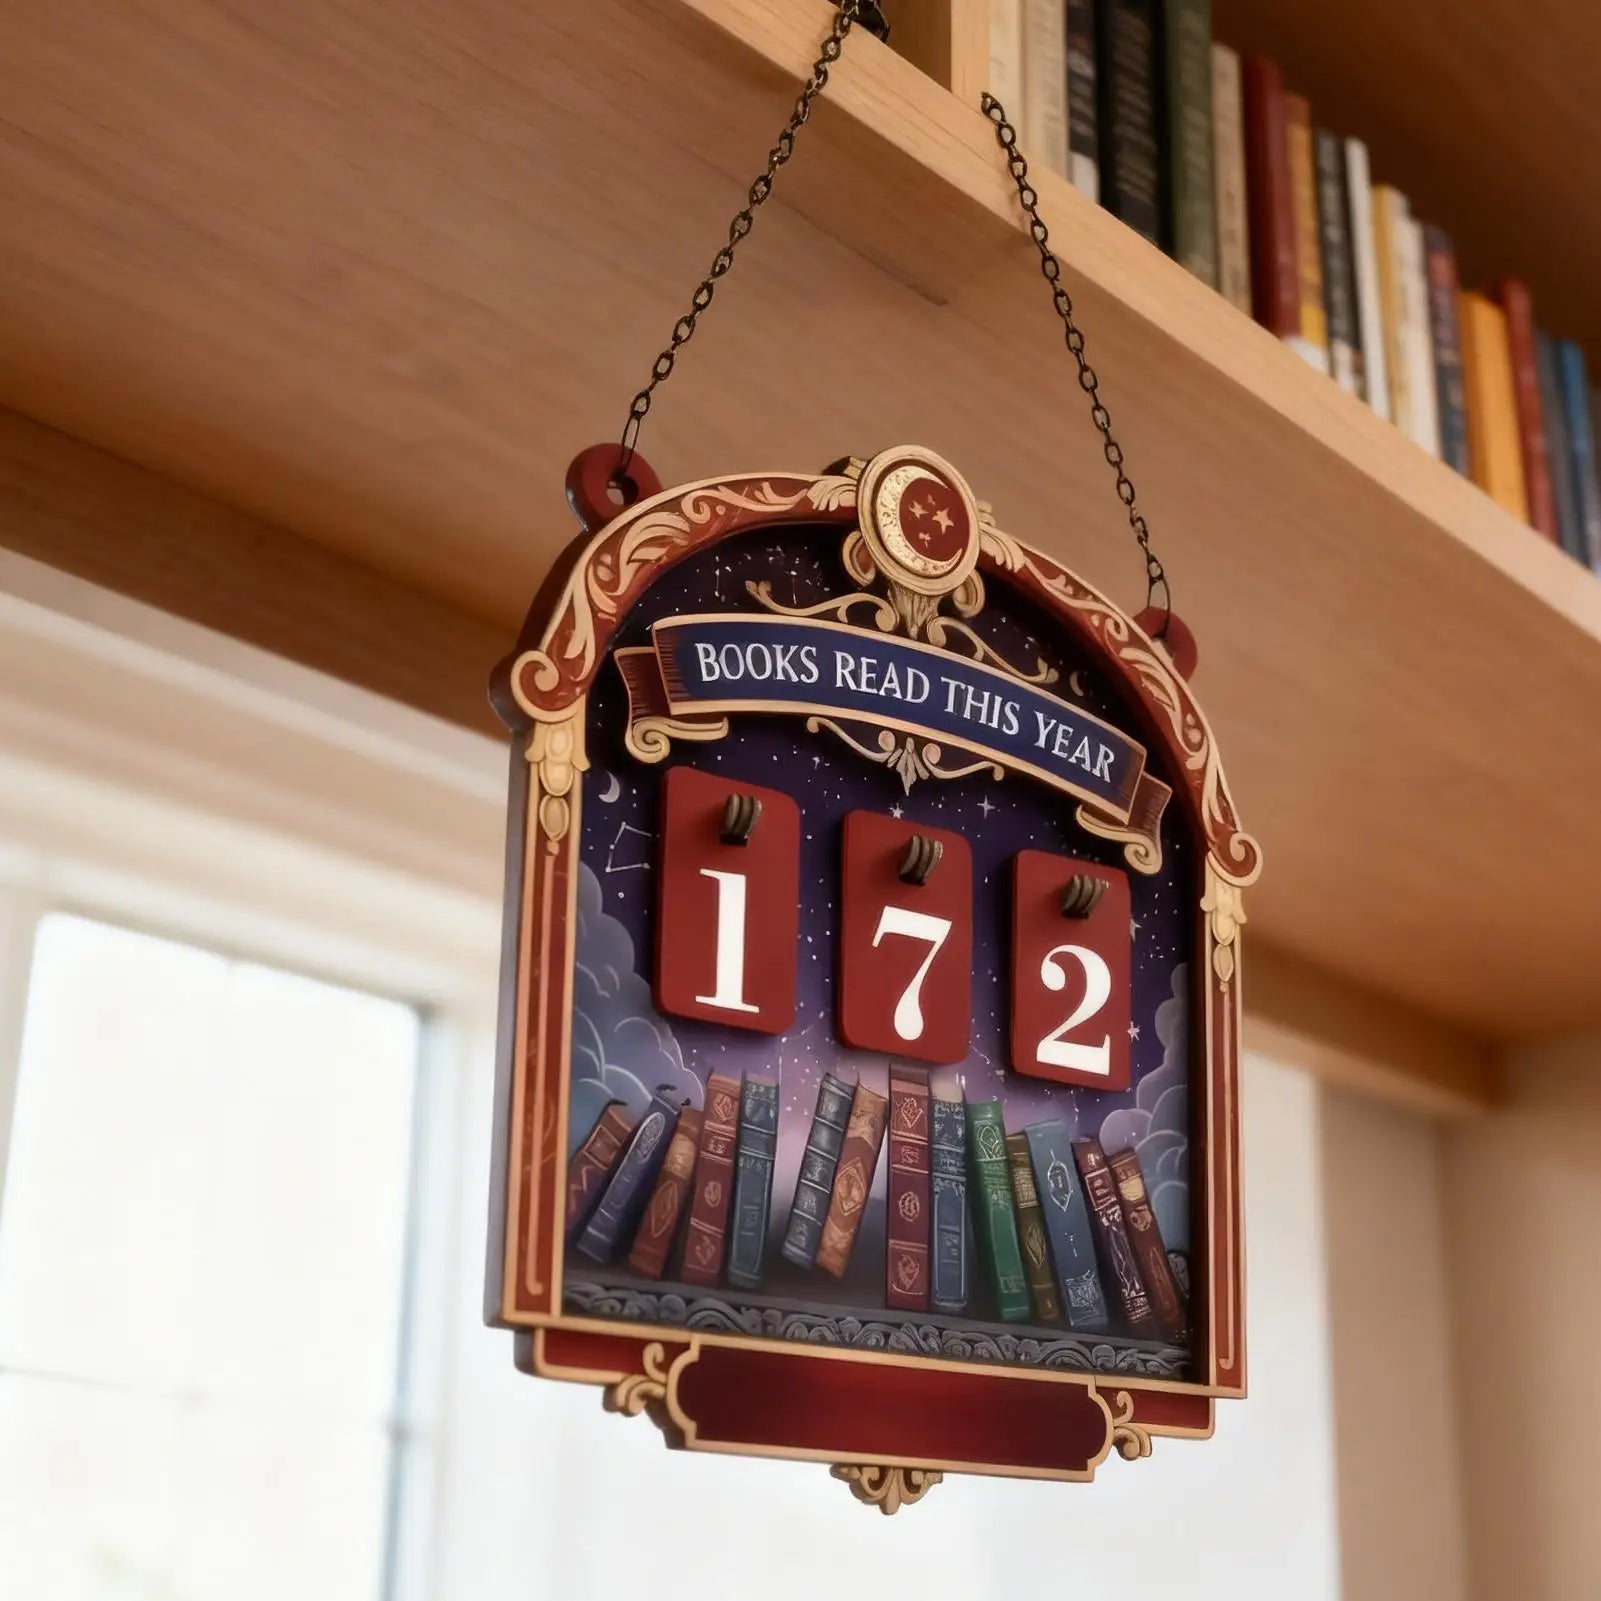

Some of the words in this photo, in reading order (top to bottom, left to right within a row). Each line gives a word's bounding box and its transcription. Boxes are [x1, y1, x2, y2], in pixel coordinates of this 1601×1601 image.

[695, 643, 818, 684] BOOKS
[834, 650, 930, 704] READ
[941, 677, 1021, 736] THIS
[1033, 711, 1116, 783] YEAR
